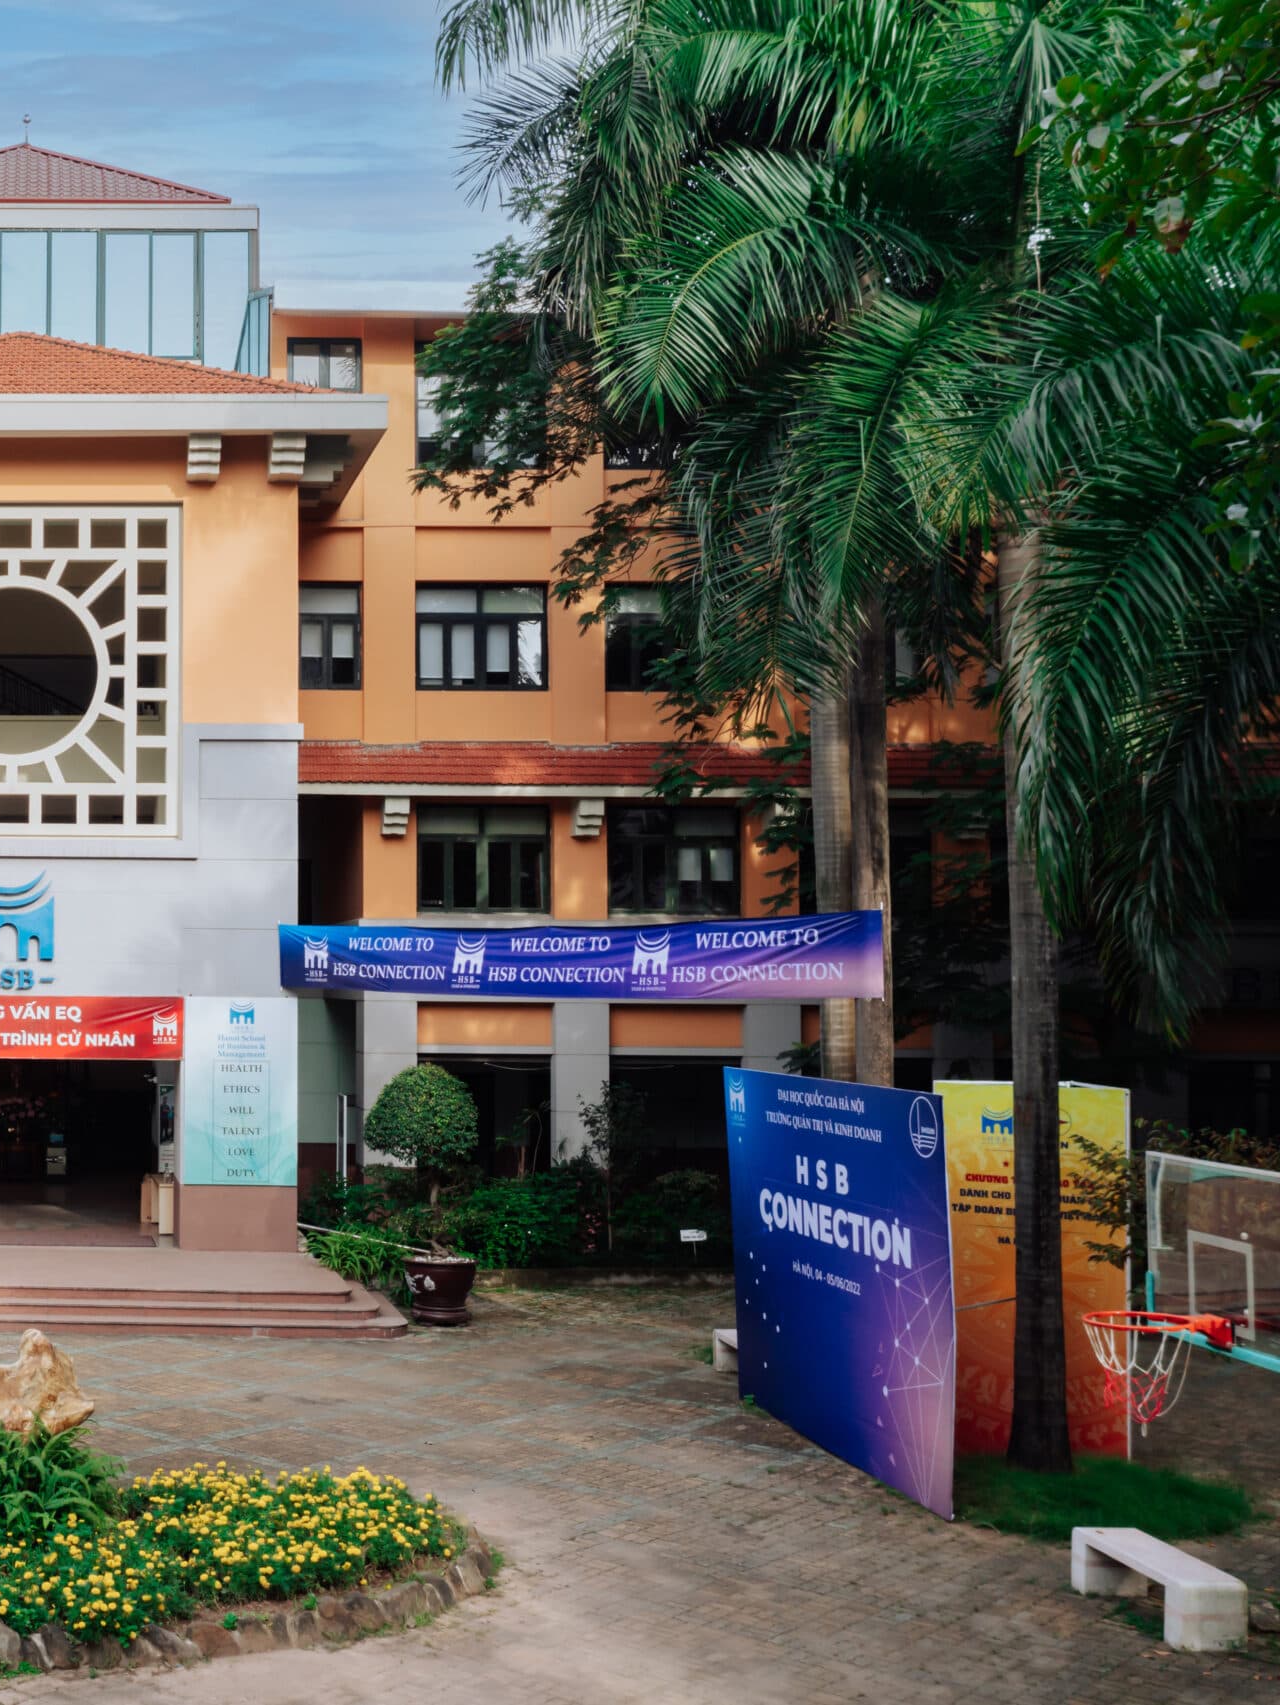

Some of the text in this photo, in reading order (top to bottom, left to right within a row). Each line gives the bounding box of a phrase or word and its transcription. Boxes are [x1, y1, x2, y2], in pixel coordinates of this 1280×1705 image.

[348, 937, 434, 952] WELCOME TO
[511, 935, 611, 953] WELCOME TO
[695, 928, 819, 950] WELCOME TO
[333, 962, 446, 981] HSB CONNECTION
[488, 966, 627, 984] HSB CONNECTION
[671, 962, 844, 983] HSB CONNECTION
[639, 976, 659, 985] HSB
[9, 1000, 50, 1020] VẤN
[55, 1005, 83, 1023] EQ
[0, 1029, 52, 1046] TRÌNH
[56, 1028, 82, 1047] CỬ
[85, 1030, 136, 1047] NHÂN
[220, 1063, 263, 1073] HEALTH
[223, 1084, 261, 1094] ETHICS
[777, 1088, 865, 1115] ĐẠI HỌC QUỐC GIA HÀ NỘI
[228, 1105, 255, 1115] WILL
[221, 1126, 262, 1136] TALENT
[765, 1110, 792, 1126] TRƯỜNG
[792, 1114, 812, 1130] QUẢN
[812, 1119, 824, 1135] TRỊ
[824, 1118, 834, 1134] VÀ
[834, 1122, 853, 1138] KINH
[854, 1126, 882, 1143] DOANH
[227, 1147, 256, 1157] LOVE
[226, 1168, 257, 1178] DUTY
[991, 1190, 1012, 1200] CHO
[759, 1188, 913, 1270] CONNECTION
[792, 1259, 801, 1273] HÀ
